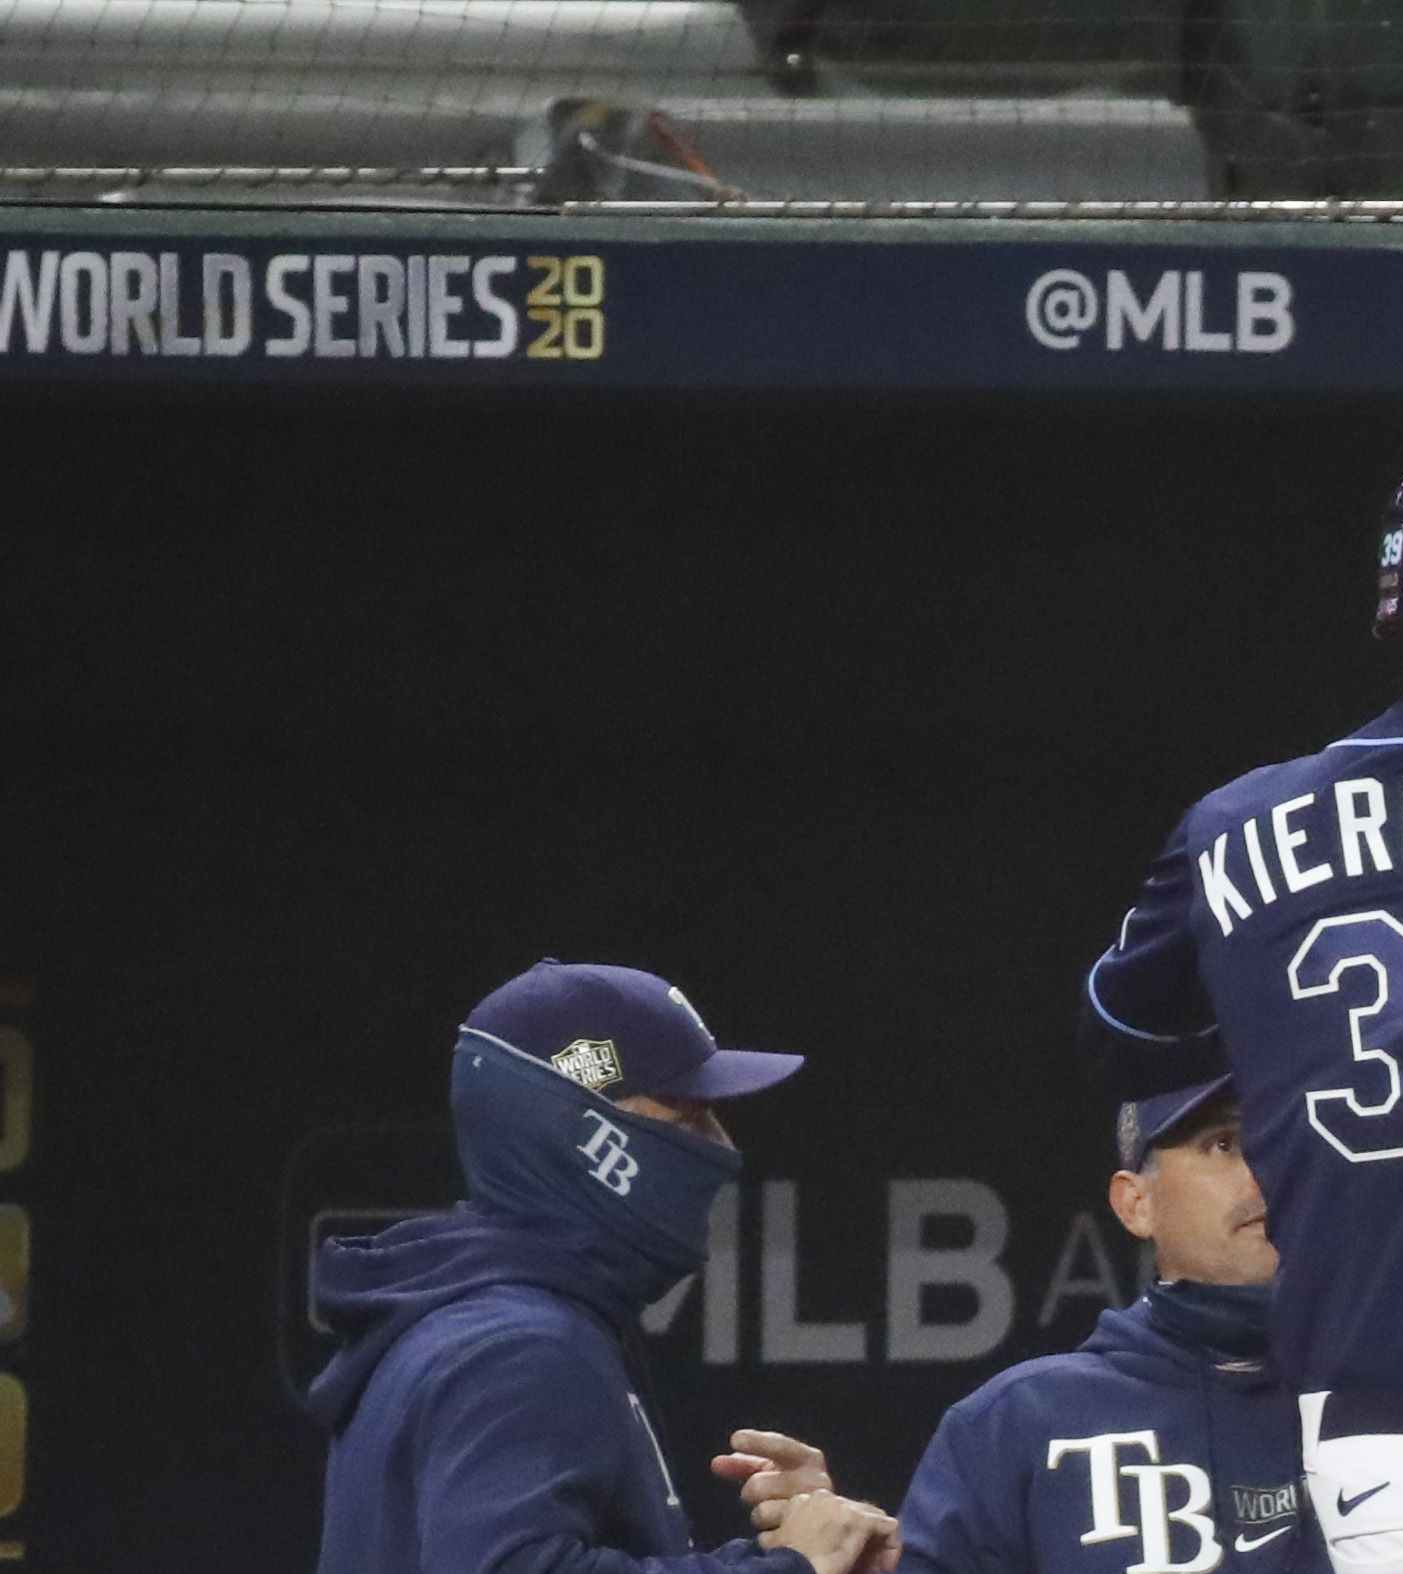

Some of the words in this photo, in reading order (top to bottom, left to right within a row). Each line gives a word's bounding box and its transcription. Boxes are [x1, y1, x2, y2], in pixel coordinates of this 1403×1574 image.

[0, 250, 252, 355] WORLD
[265, 255, 518, 359] SERIES
[526, 256, 604, 305] 20
[526, 308, 604, 359] 20
[1025, 269, 1294, 352] @MLB
[1381, 529, 1403, 568] 39
[557, 1047, 611, 1074] WORLD
[571, 1061, 617, 1086] ERIES
[576, 1108, 640, 1197] TB
[1233, 1484, 1297, 1520] WORL
